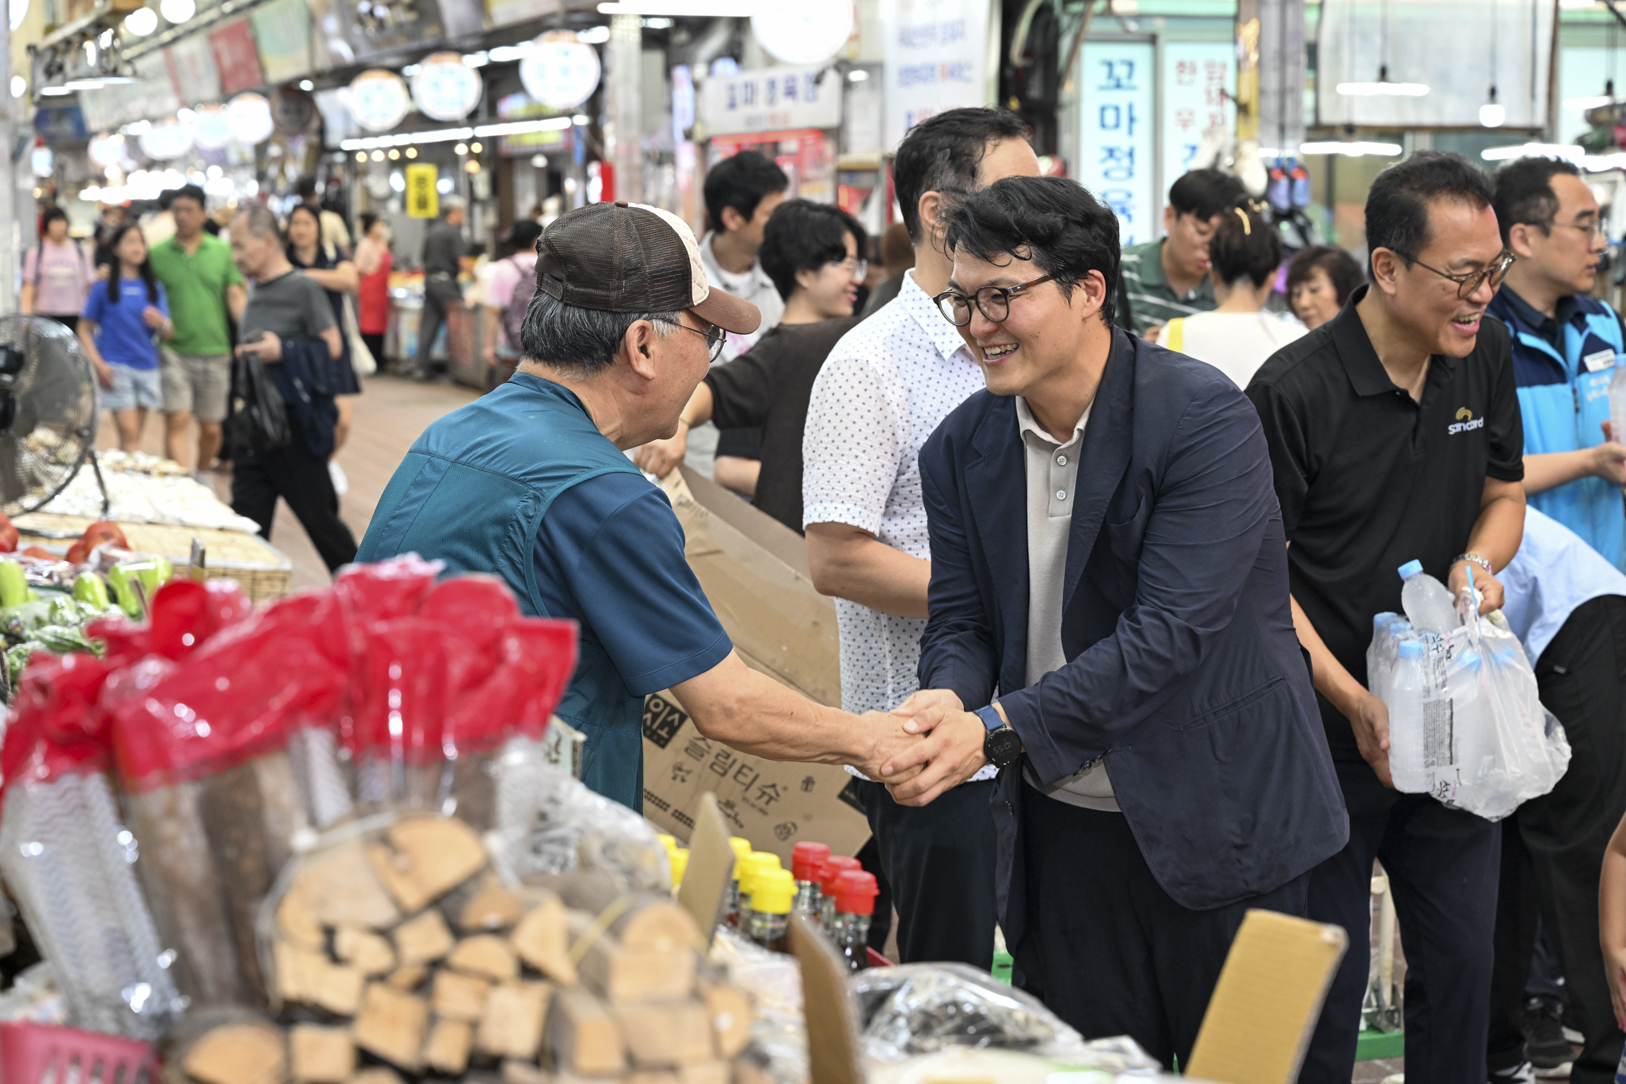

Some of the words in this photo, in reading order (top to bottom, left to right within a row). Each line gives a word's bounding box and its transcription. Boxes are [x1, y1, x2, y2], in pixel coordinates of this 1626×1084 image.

[1098, 59, 1138, 246] 꼬마정육
[1448, 416, 1484, 435] sancard
[684, 736, 780, 806] 슬림티슈
